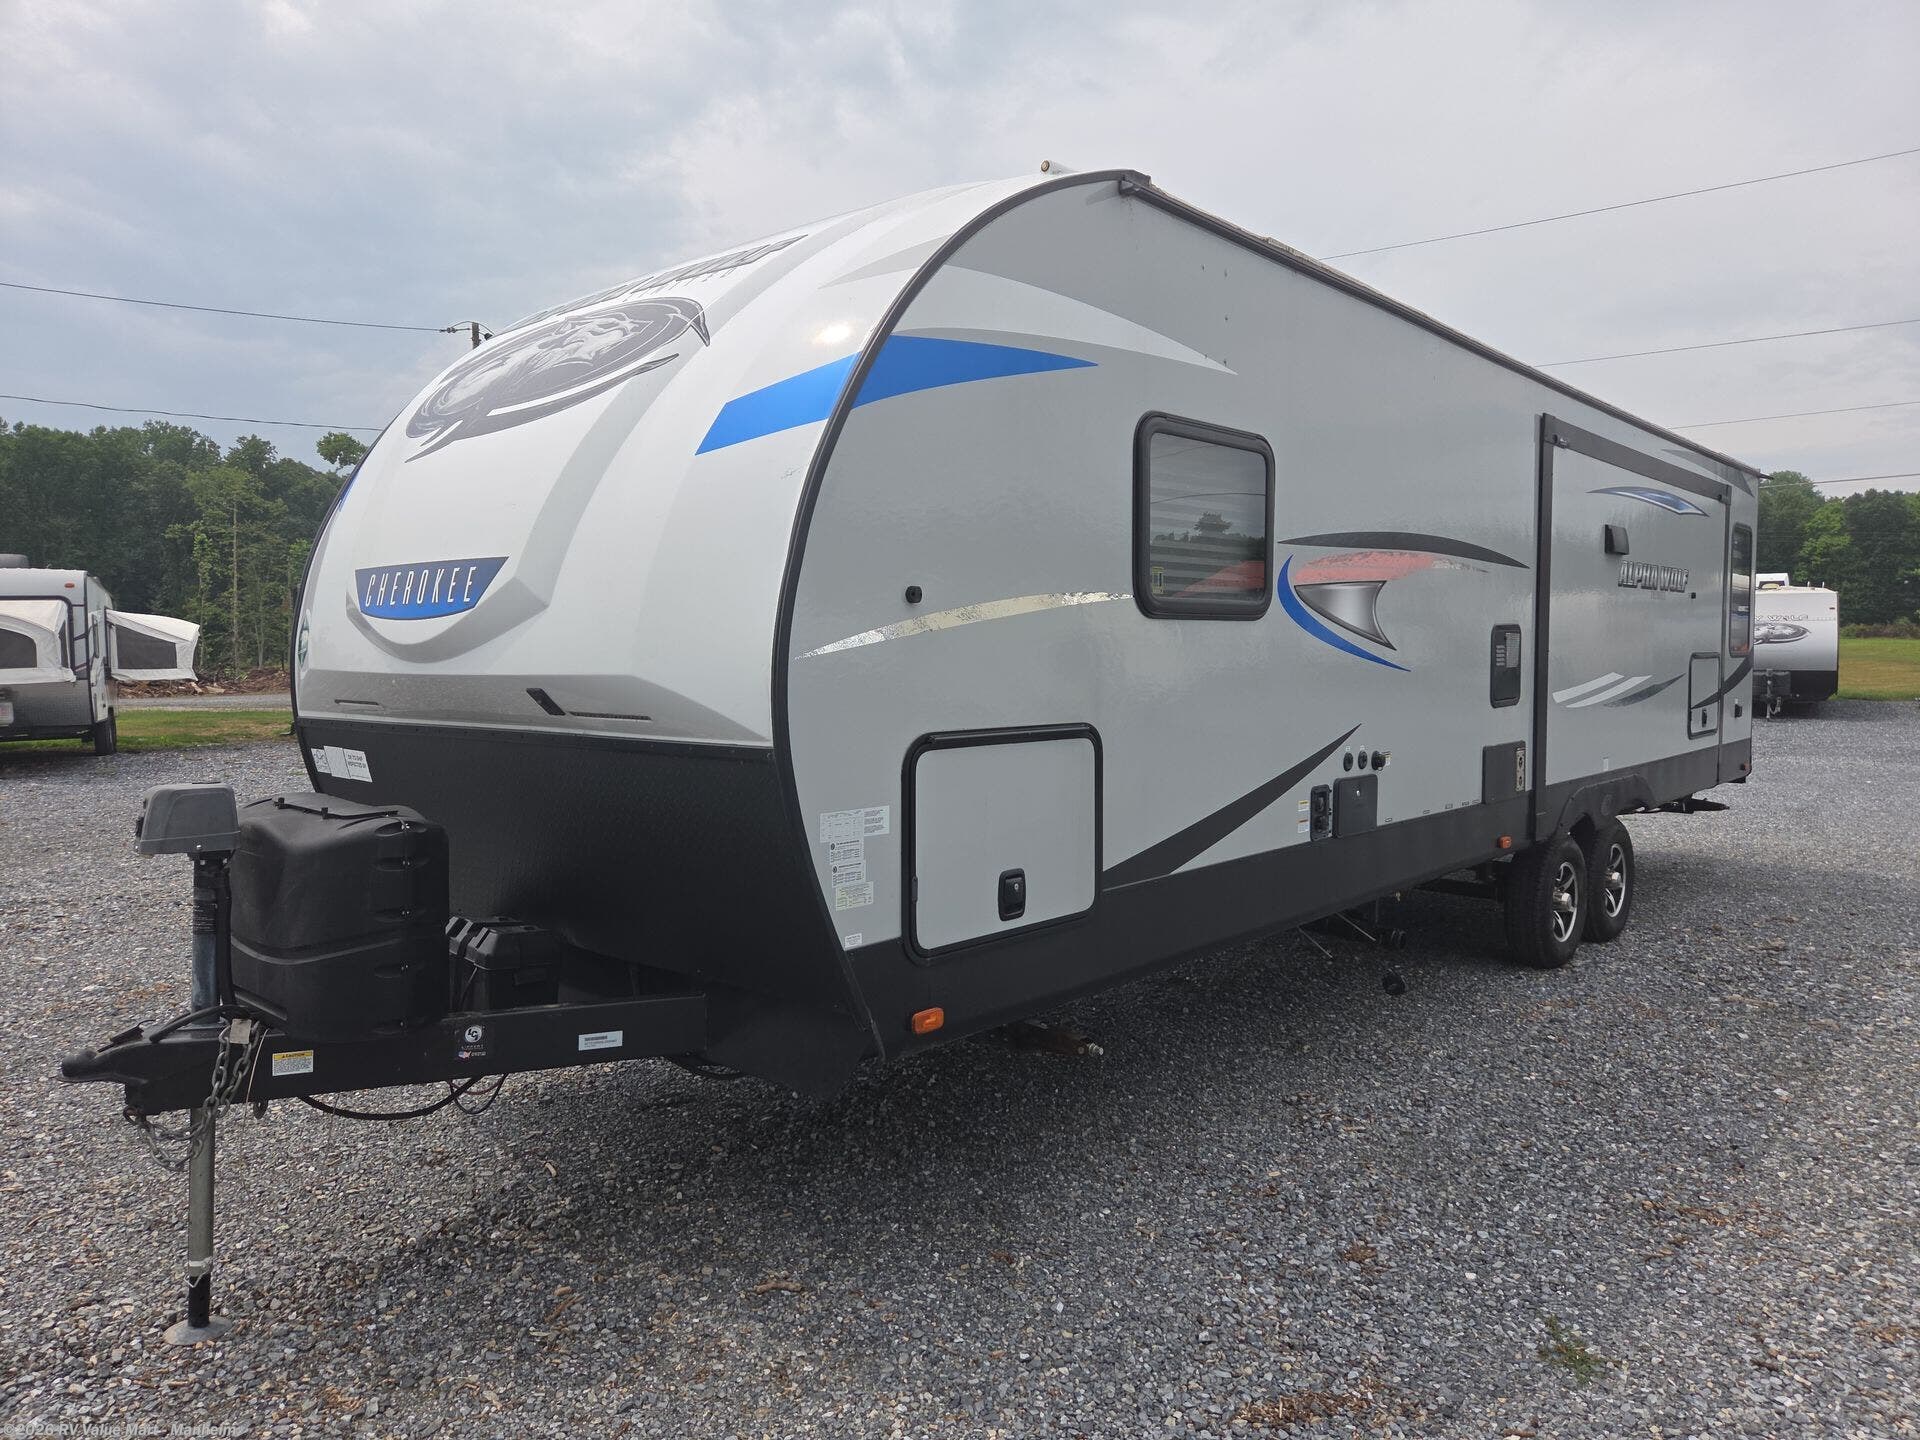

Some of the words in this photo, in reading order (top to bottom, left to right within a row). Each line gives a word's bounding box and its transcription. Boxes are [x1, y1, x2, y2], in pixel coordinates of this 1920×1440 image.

[365, 566, 477, 607] CHEROKEE
[1618, 560, 1658, 590] ALPHA
[1659, 565, 1688, 593] WOLF
